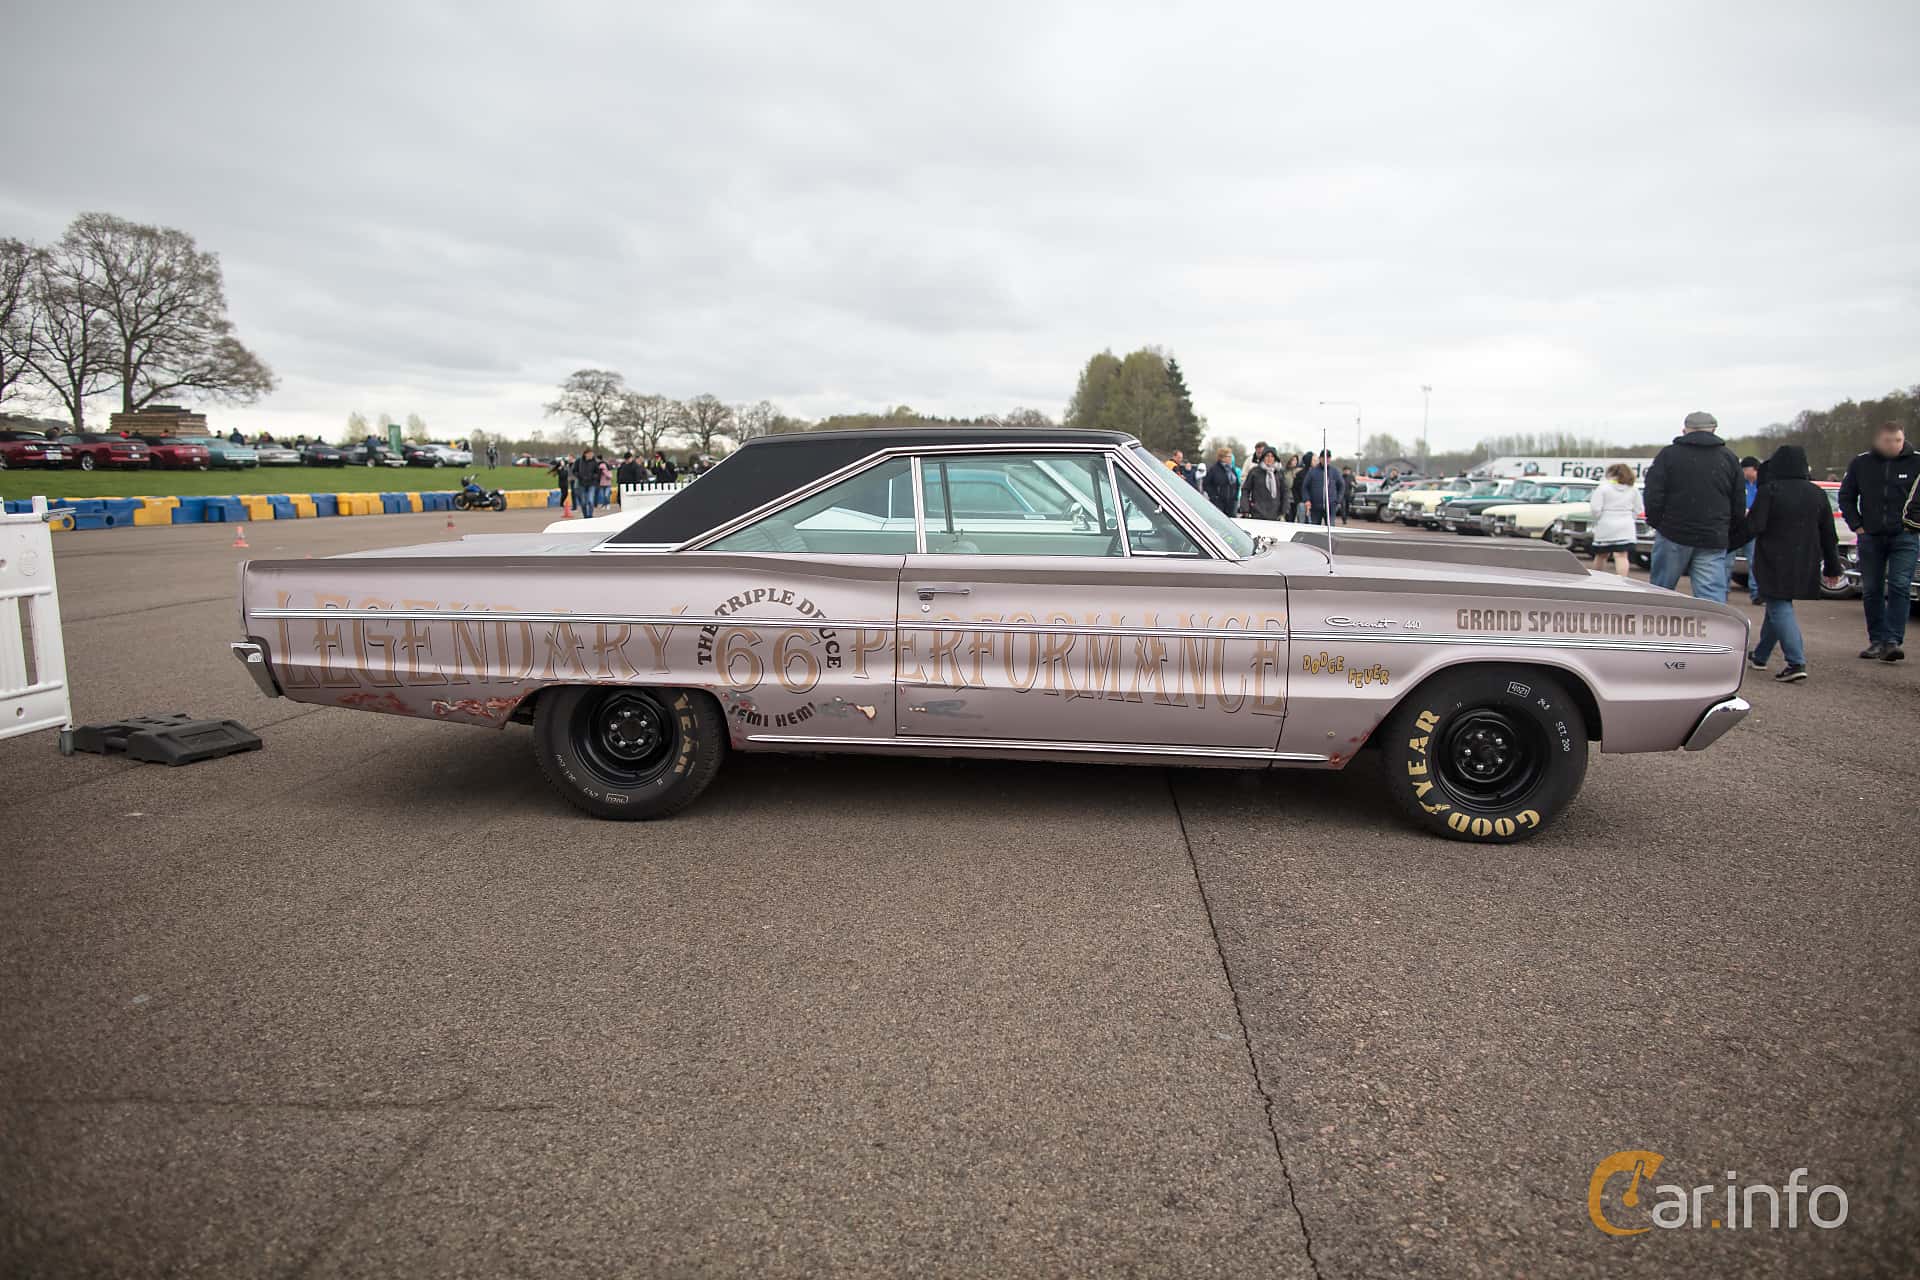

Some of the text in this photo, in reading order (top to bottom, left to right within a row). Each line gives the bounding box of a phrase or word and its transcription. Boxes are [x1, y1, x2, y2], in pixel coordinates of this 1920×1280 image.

[697, 624, 718, 665] THE
[715, 588, 795, 617] TRIPLE
[1455, 608, 1707, 638] GRAND SPAULDING DODGE
[277, 590, 1290, 719] LEGENDARY 66 PERFORMANCE
[1303, 651, 1345, 675] DODGE
[1347, 663, 1390, 689] FEVER
